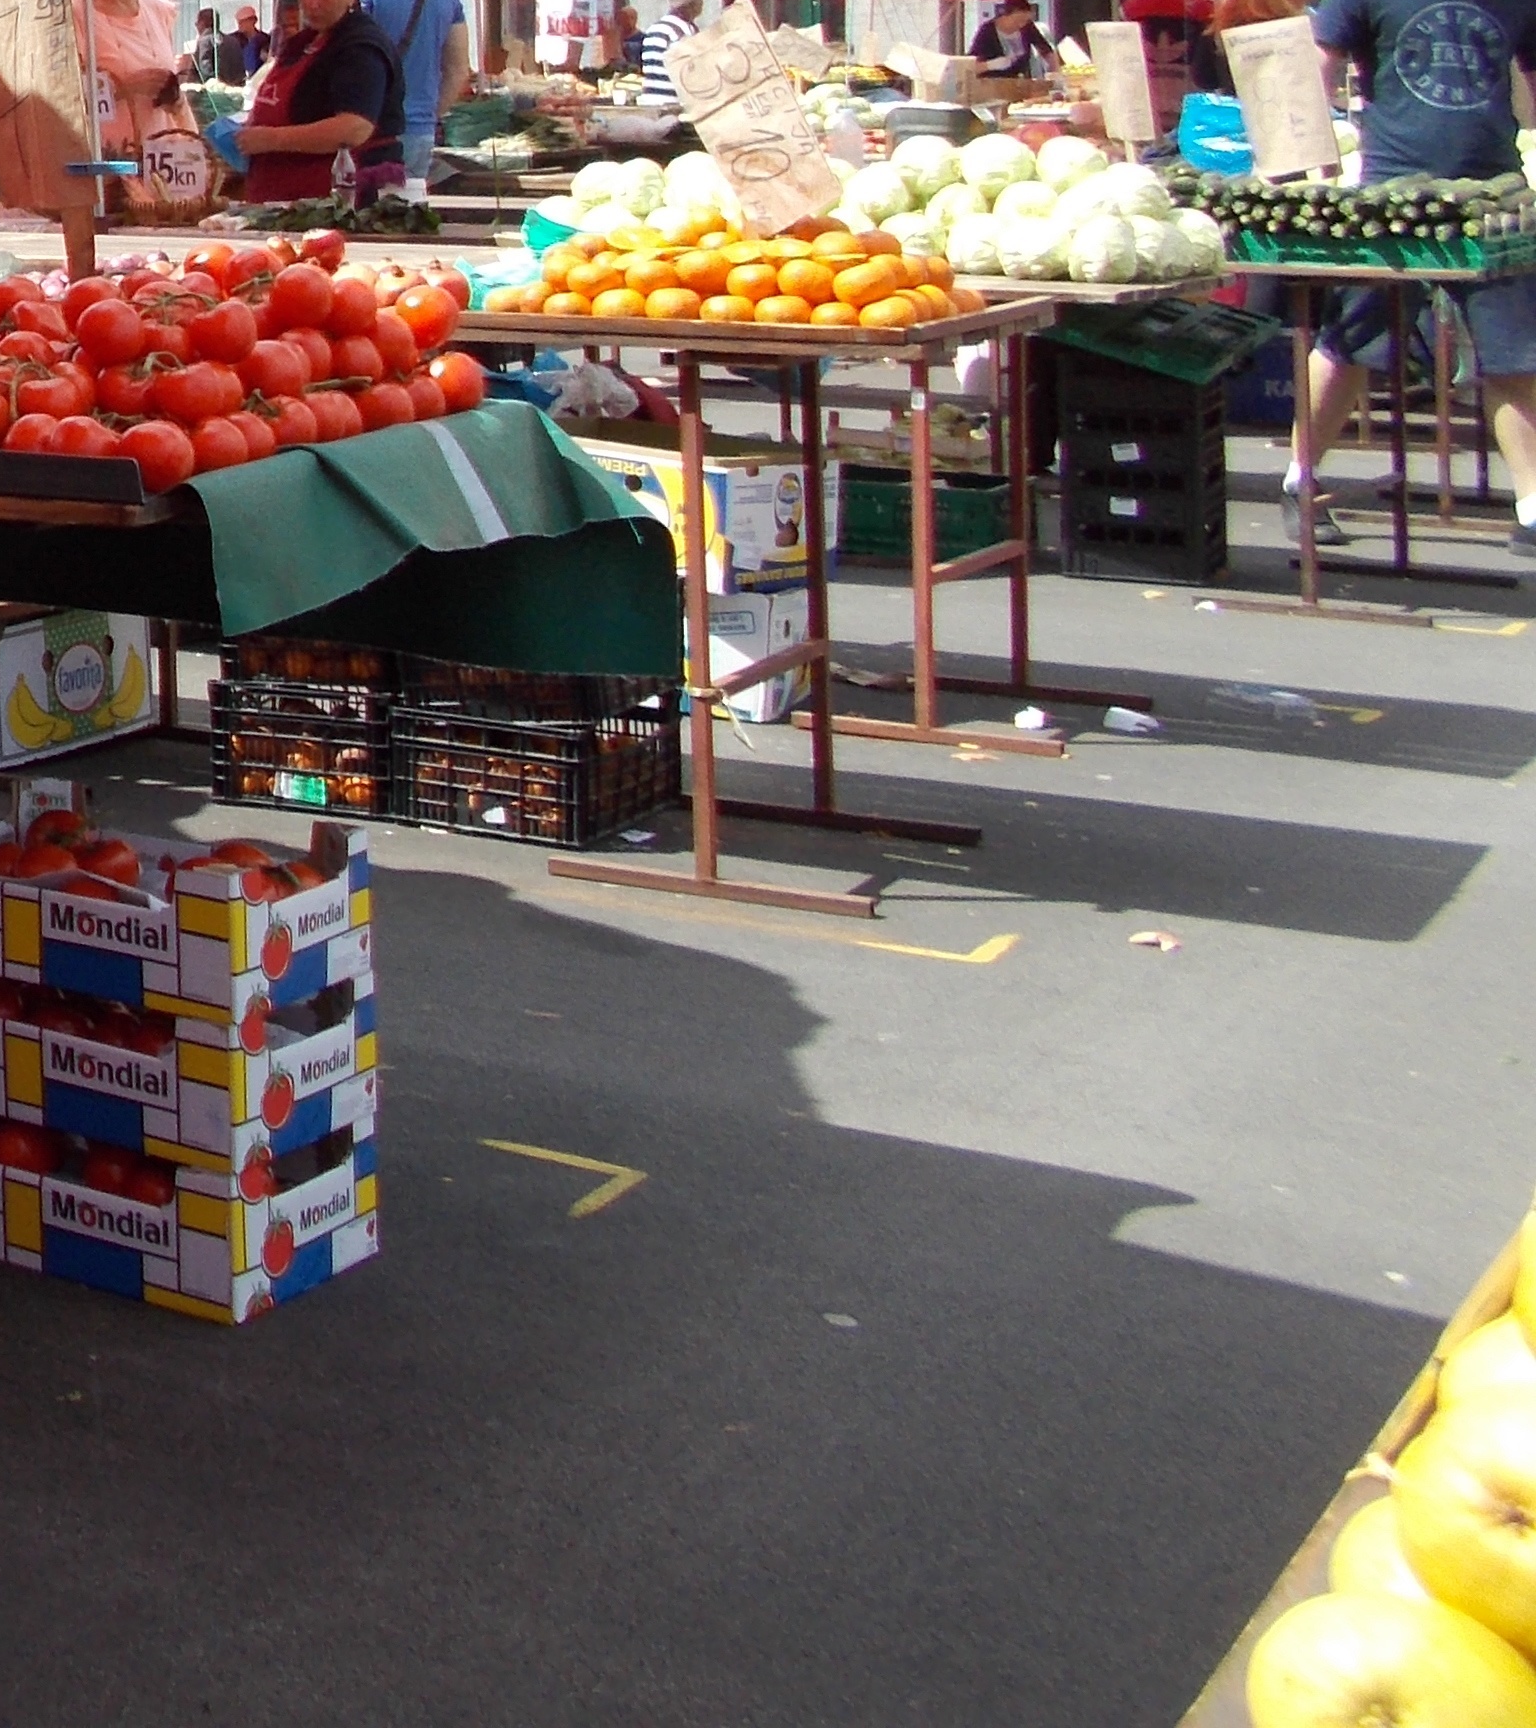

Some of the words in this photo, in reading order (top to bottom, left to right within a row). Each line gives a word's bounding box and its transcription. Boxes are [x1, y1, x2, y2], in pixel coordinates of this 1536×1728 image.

[716, 128, 792, 182] 10
[58, 655, 102, 695] favorita
[49, 901, 168, 953] Mondial
[297, 898, 346, 937] Mondial
[50, 1042, 169, 1098] Mondial
[299, 1047, 351, 1086] Mondial
[51, 1189, 170, 1248] Mondial
[299, 1193, 351, 1232] Mondial
